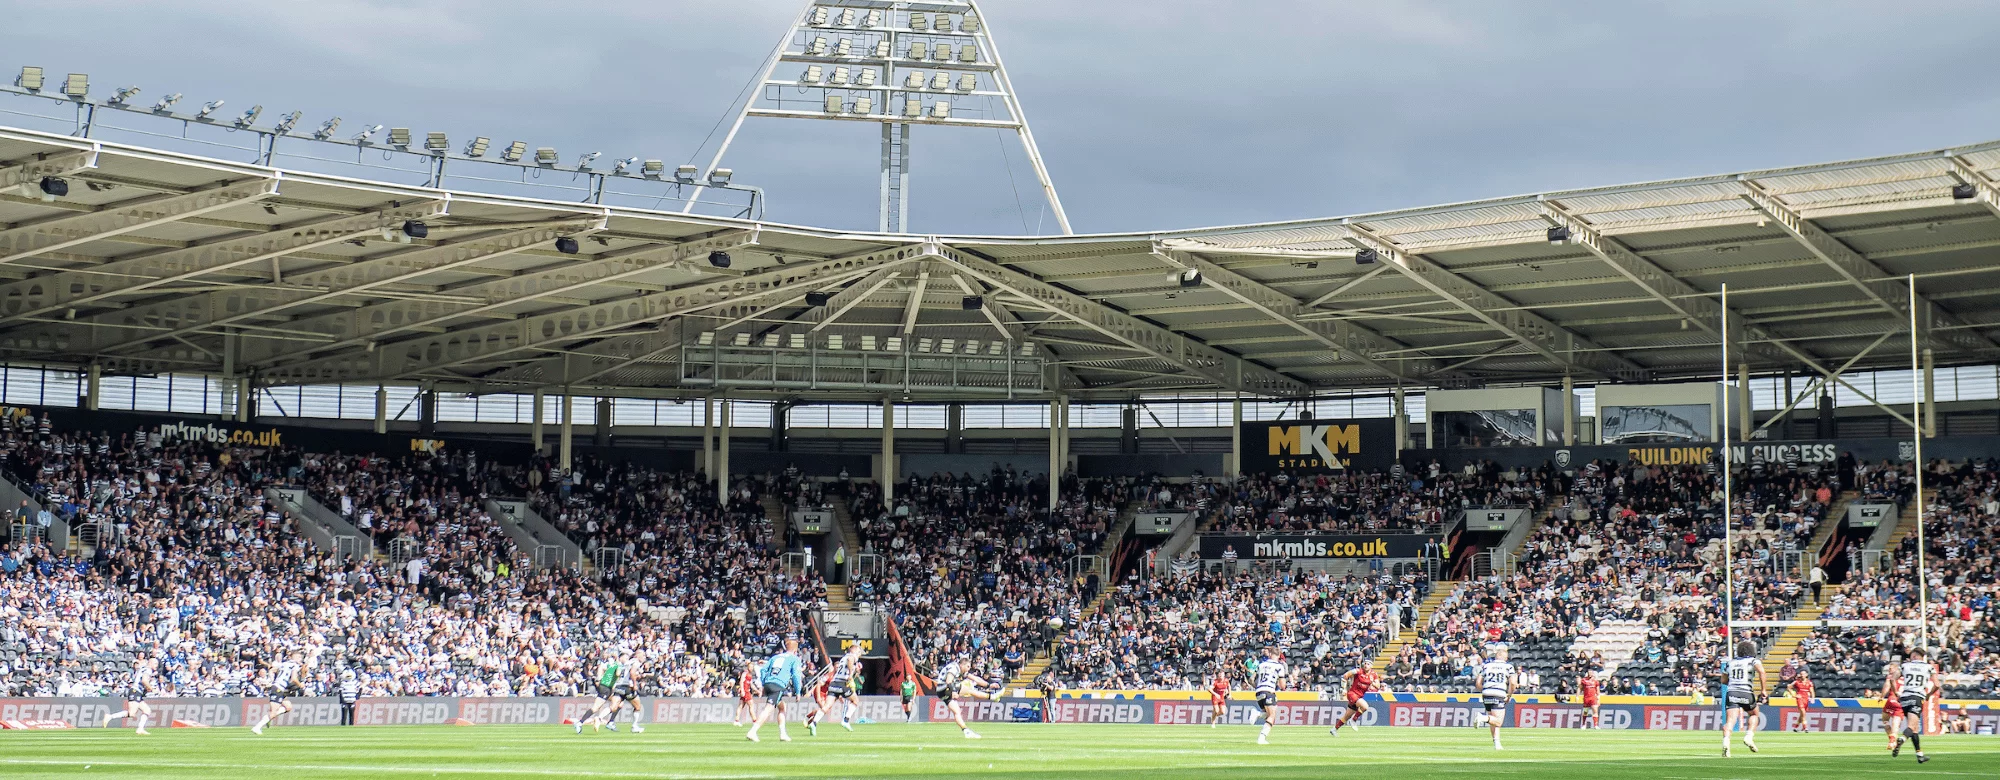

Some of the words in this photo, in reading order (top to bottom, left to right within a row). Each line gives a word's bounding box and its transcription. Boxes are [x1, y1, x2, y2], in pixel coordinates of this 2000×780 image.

[1268, 424, 1360, 469] MKM
[1278, 458, 1351, 468] STADIUM
[1253, 538, 1388, 557] mkmbs.co.uk
[1732, 668, 1744, 679] 10
[1905, 673, 1924, 687] 29
[245, 703, 341, 725] BFRED
[357, 702, 449, 724] BETFRED
[463, 703, 549, 723] BETFRED
[657, 703, 734, 722] BETFRED
[1274, 705, 1378, 726] BETFRD
